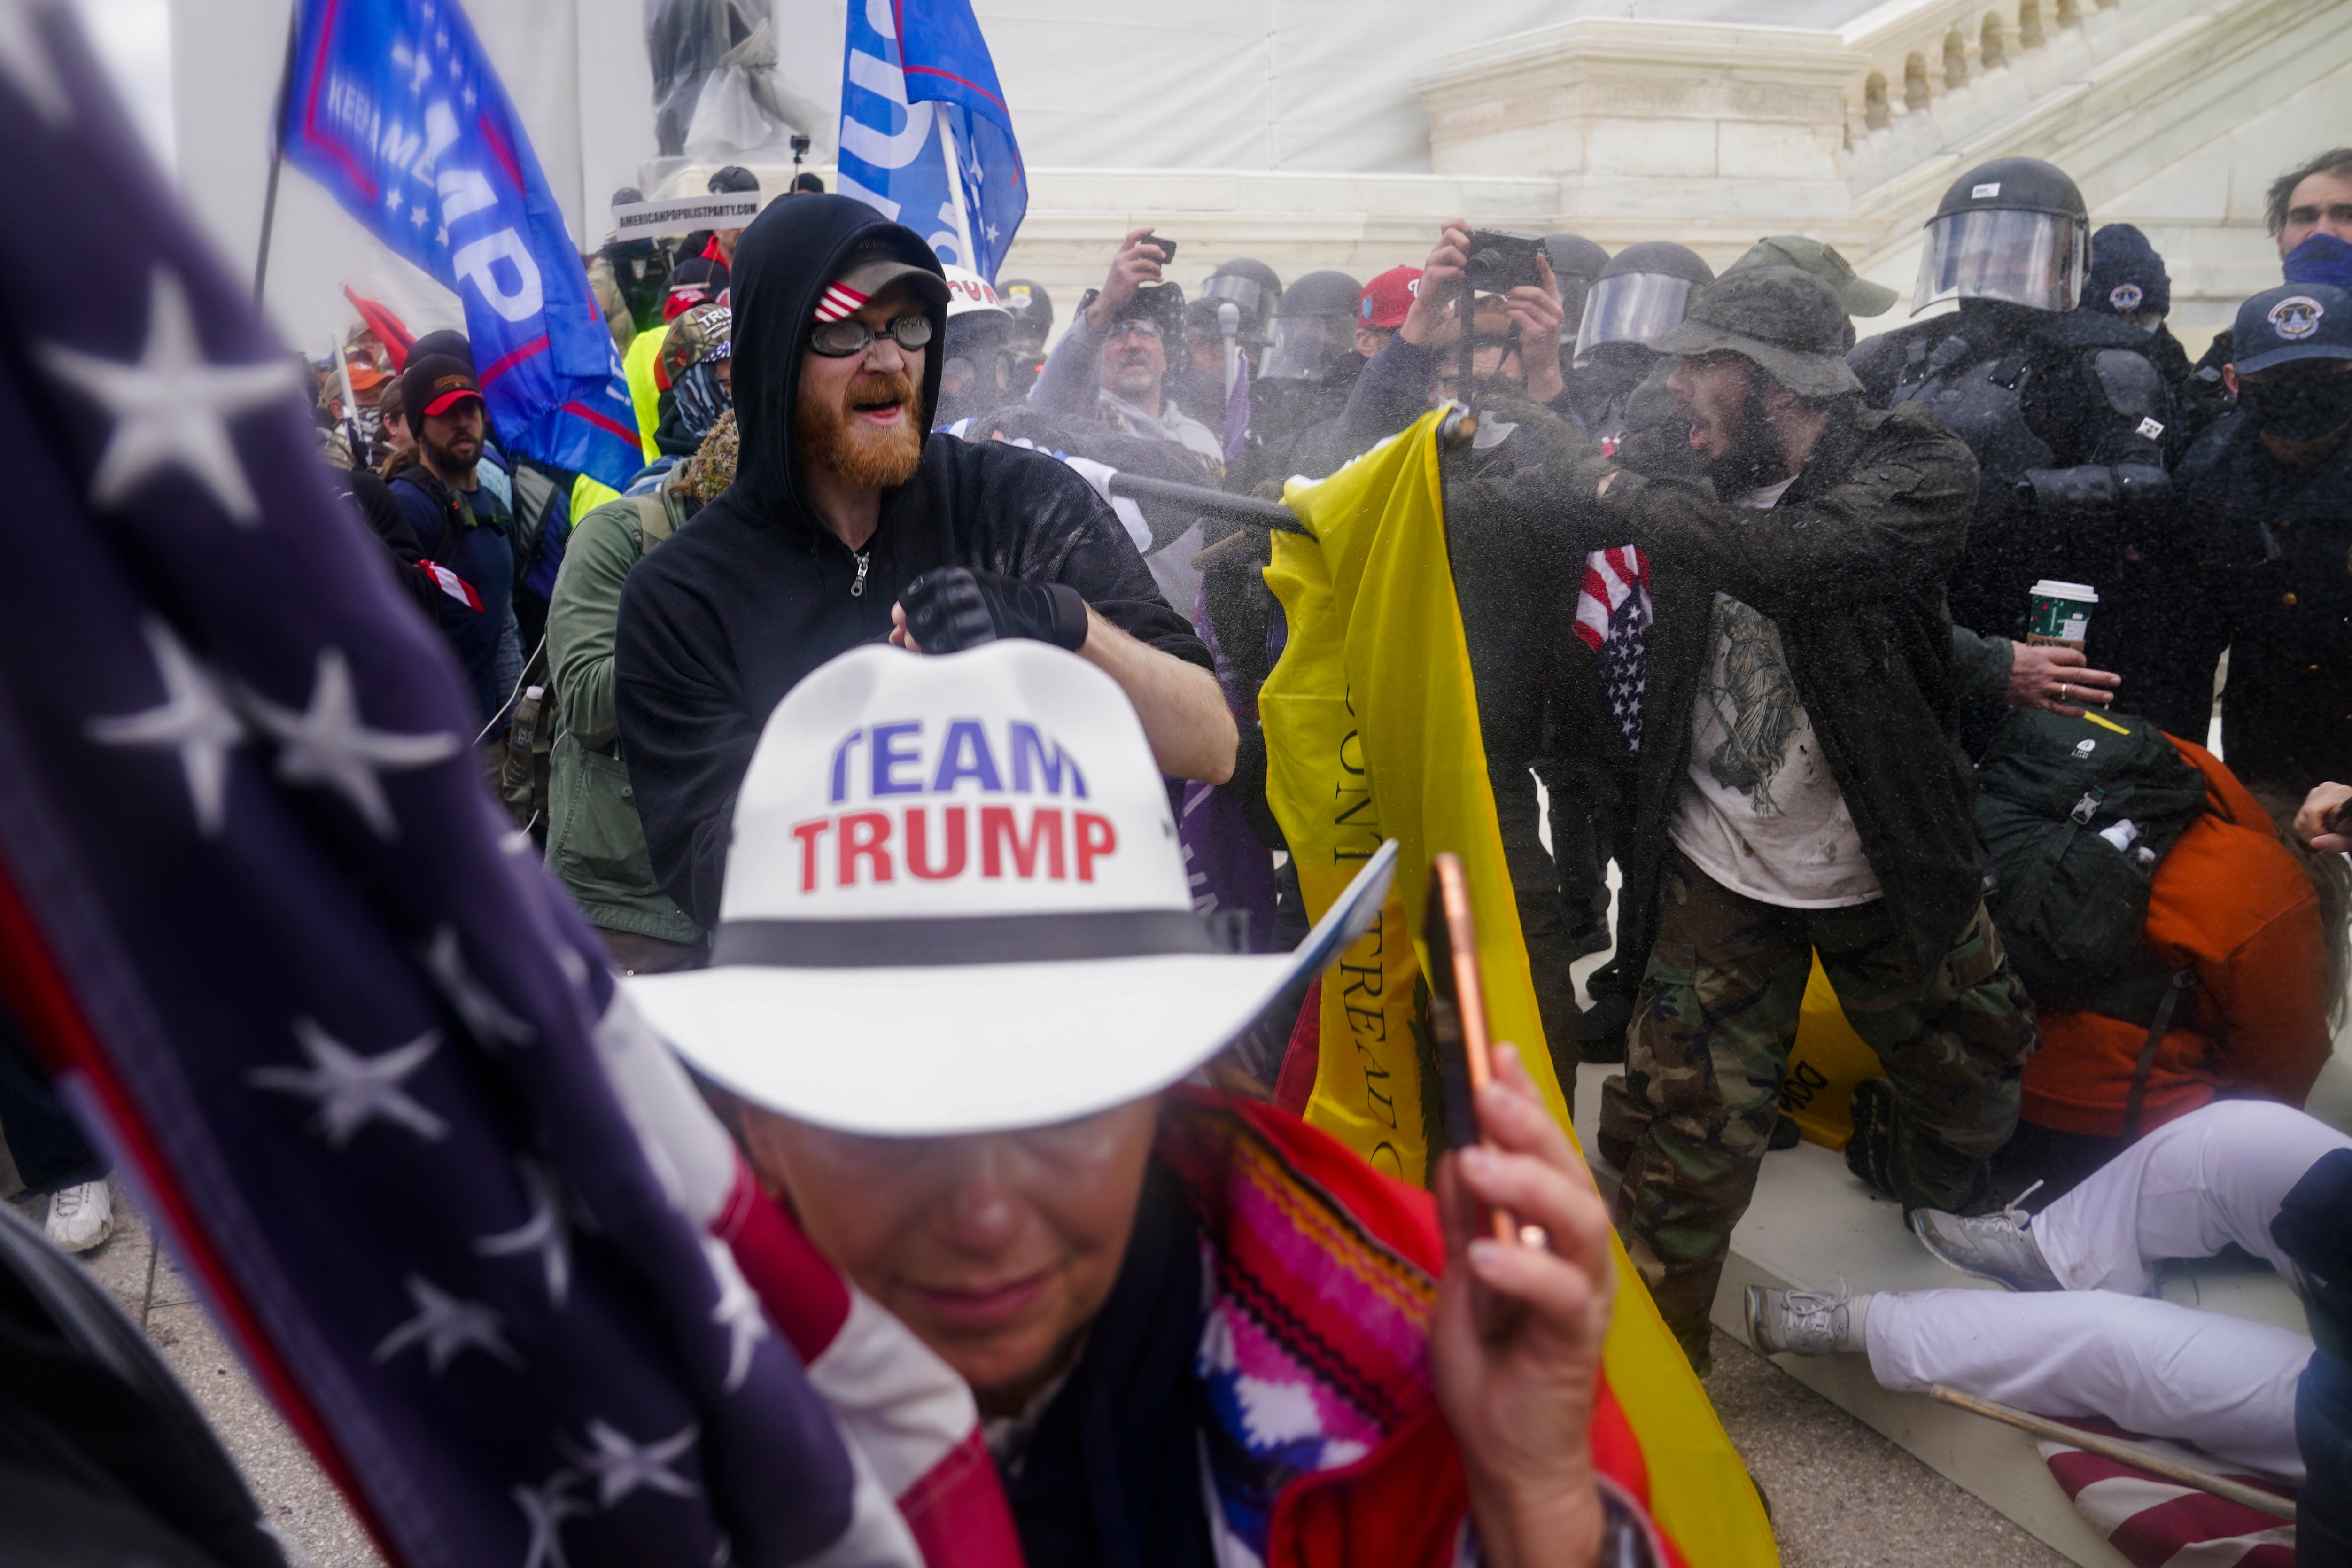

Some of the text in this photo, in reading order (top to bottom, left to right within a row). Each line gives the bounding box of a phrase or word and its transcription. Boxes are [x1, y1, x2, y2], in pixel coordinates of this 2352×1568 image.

[619, 202, 758, 228] AMERICANPOPULISTPARTY.COM
[697, 307, 732, 328] TRU
[829, 720, 1089, 804] TEAM
[792, 805, 1117, 893] TRUMP
